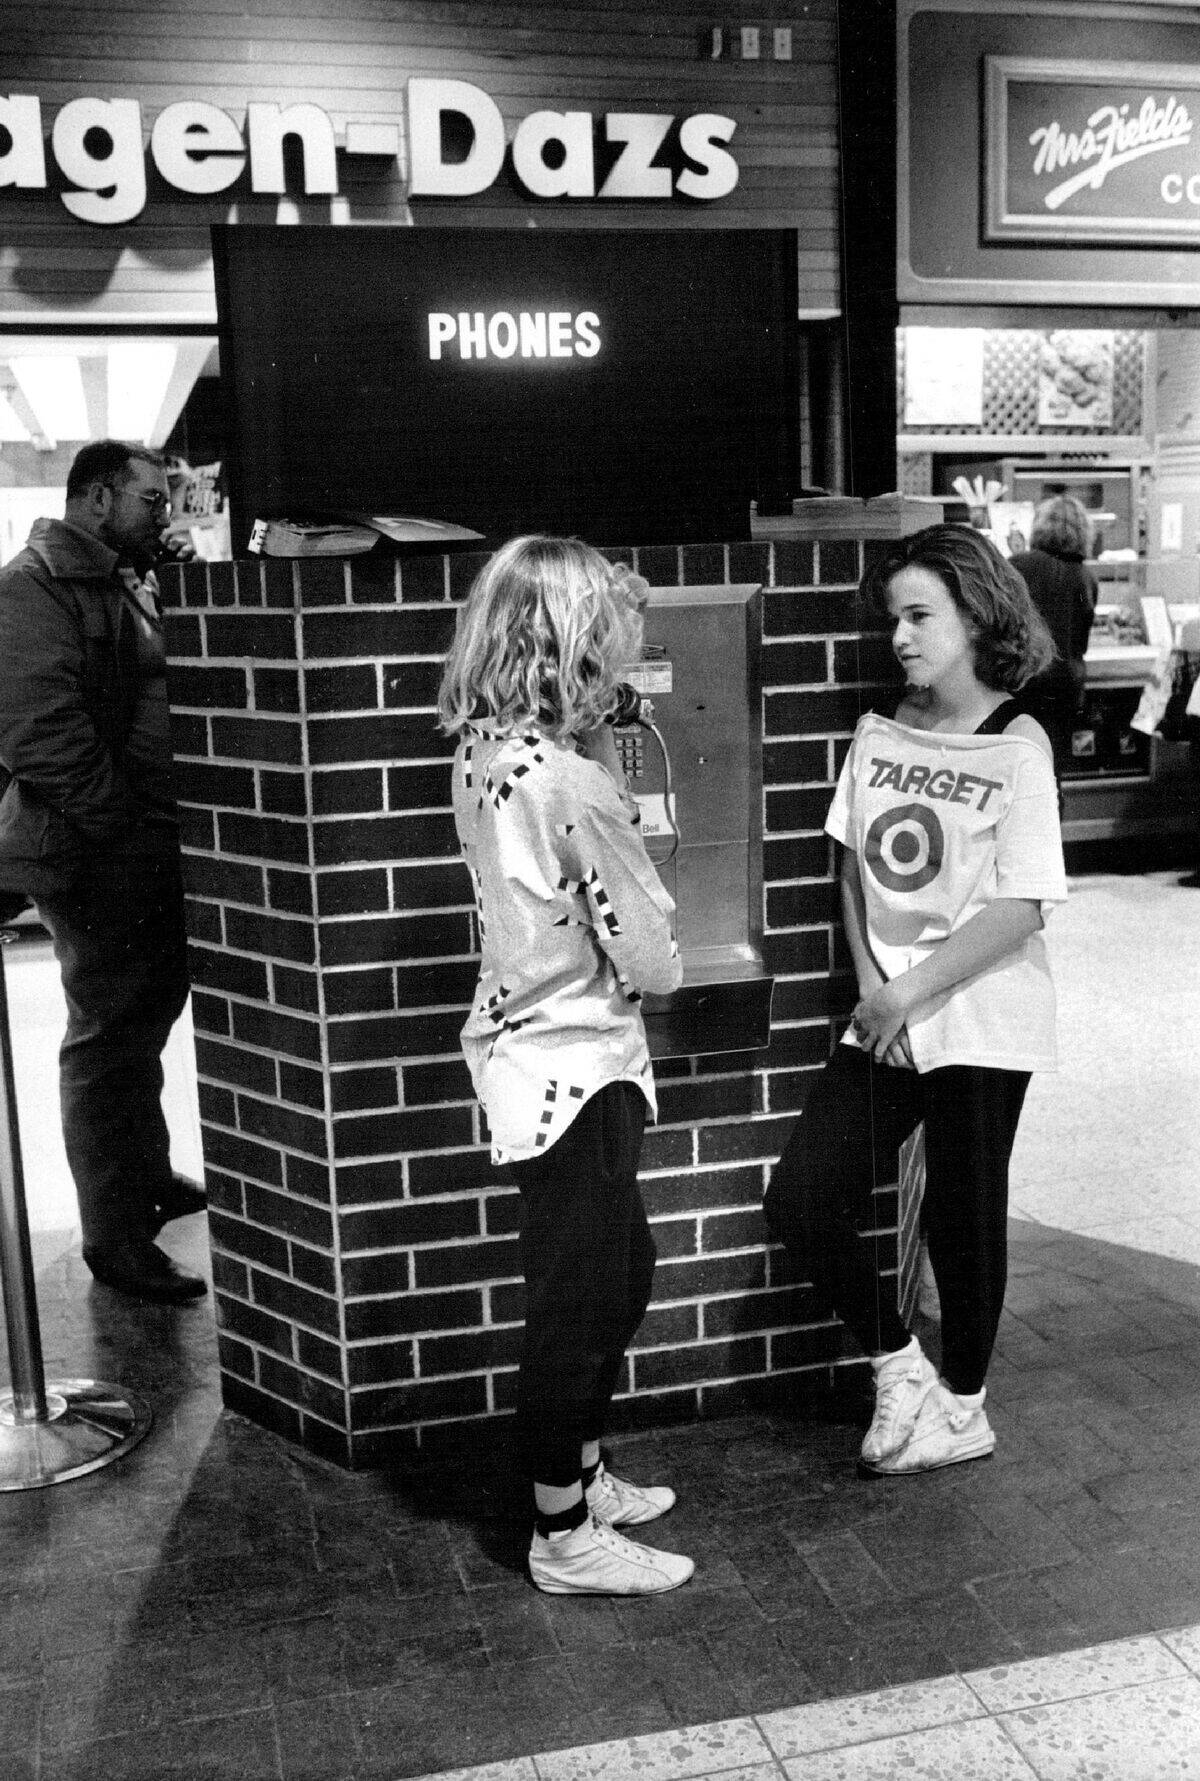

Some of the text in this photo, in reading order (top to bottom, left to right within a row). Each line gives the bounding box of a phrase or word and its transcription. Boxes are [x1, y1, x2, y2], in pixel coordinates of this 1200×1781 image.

[1088, 96, 1193, 189] Fields
[428, 311, 601, 360] PHONES
[868, 757, 1004, 812] TARGET
[642, 823, 660, 834] Bell
